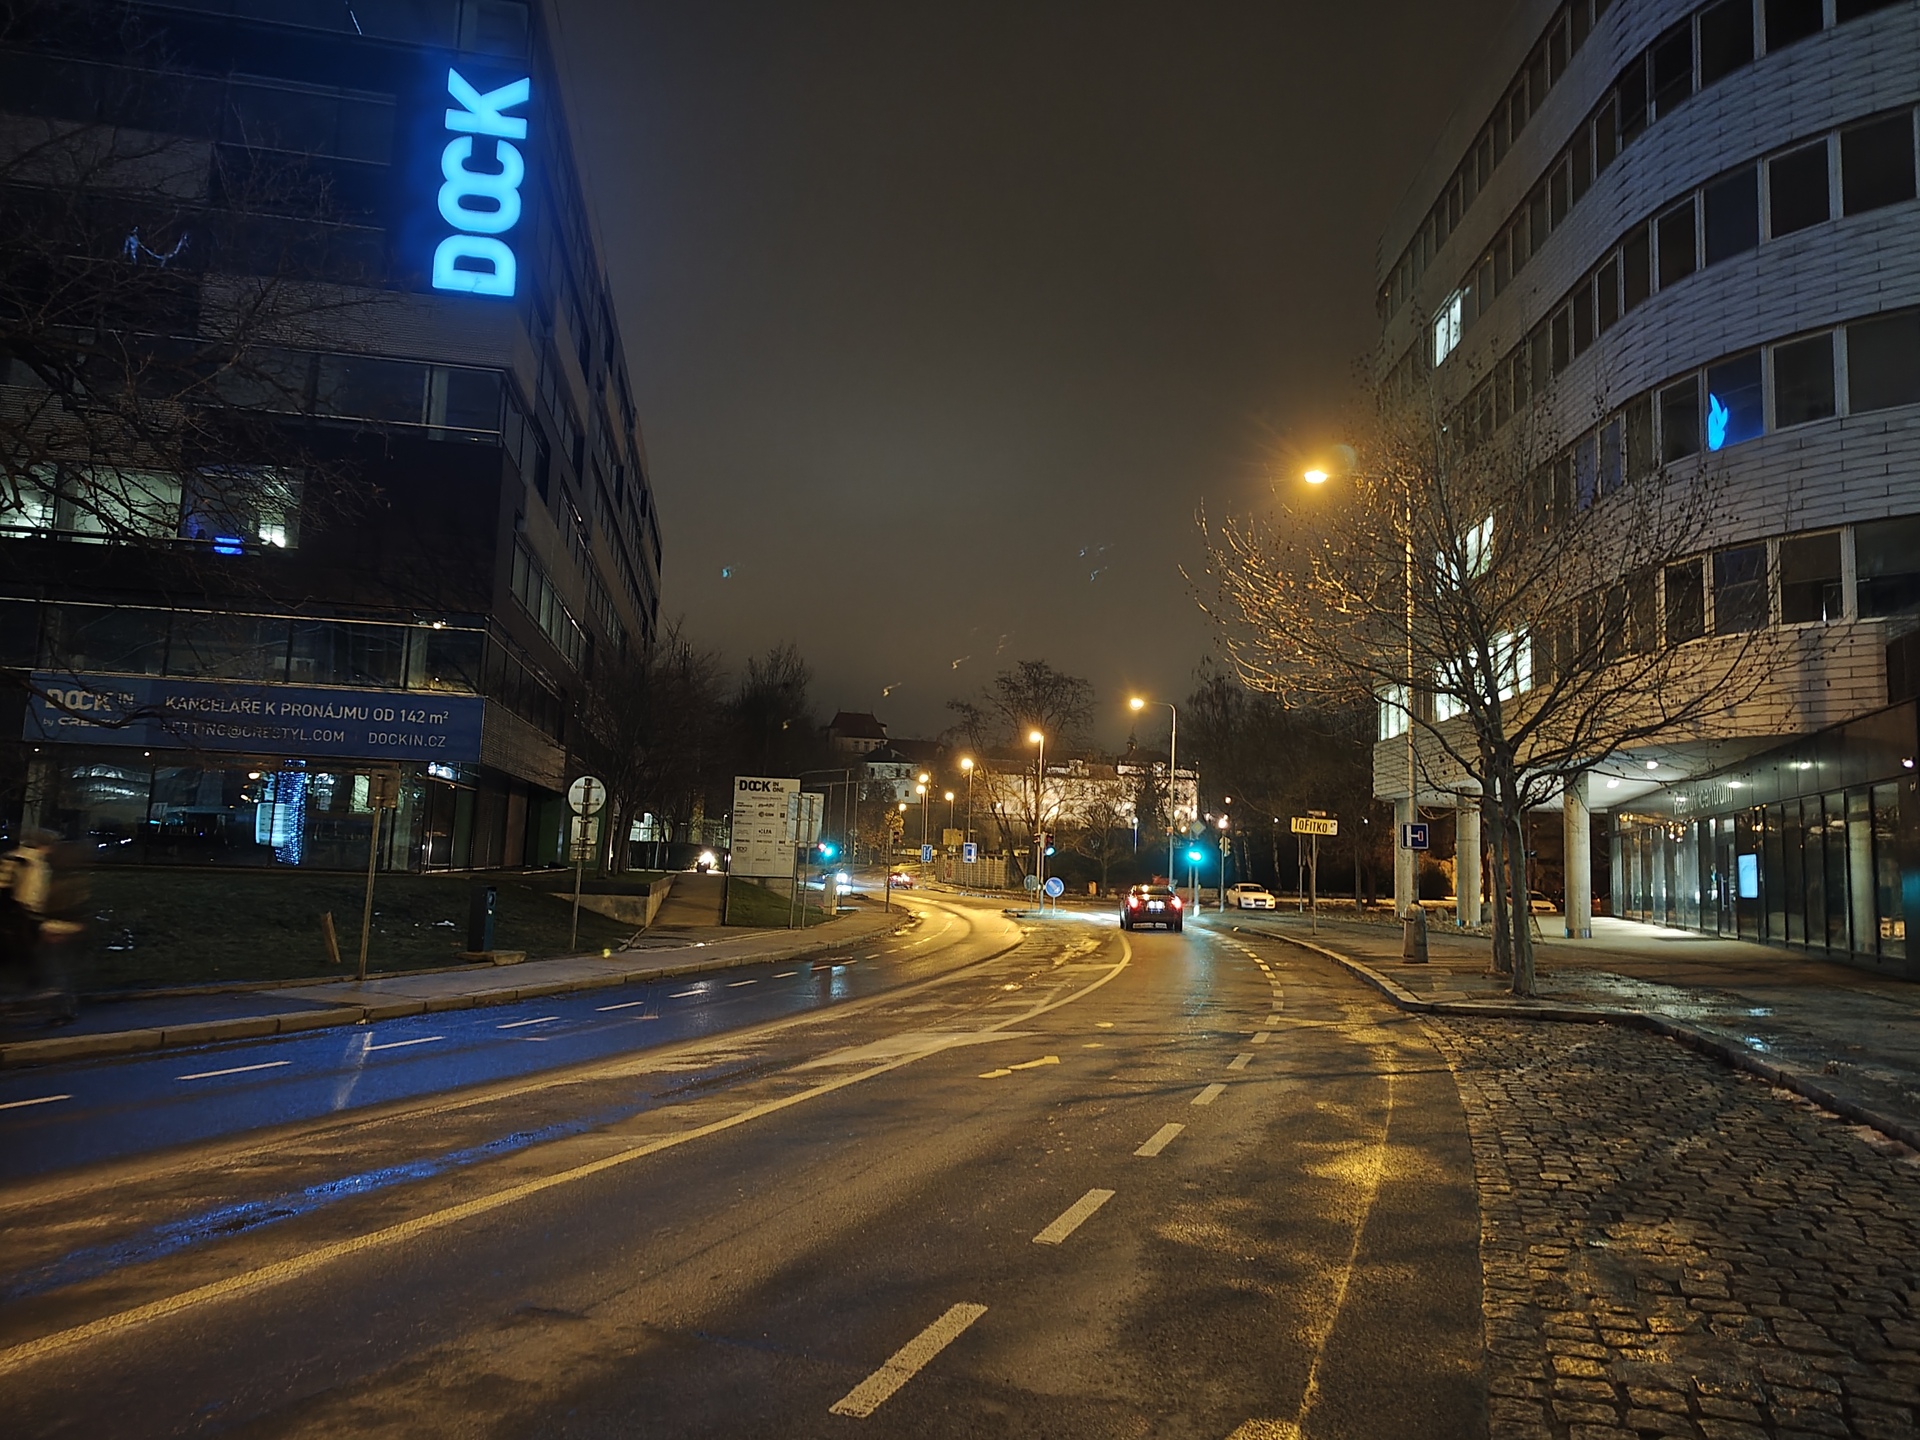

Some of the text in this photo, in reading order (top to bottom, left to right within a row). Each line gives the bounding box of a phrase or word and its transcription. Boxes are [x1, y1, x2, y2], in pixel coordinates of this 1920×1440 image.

[432, 67, 530, 297] DOCK
[45, 688, 135, 712] DOCK IN
[43, 717, 54, 727] by
[265, 701, 276, 716] K
[280, 702, 369, 721] PRONÁJMU
[373, 708, 395, 722] OD
[400, 709, 425, 724] 142
[162, 720, 446, 747] LETTNG@CRESTYL.COM DOCKIN.CZ
[739, 779, 771, 792] DOCK
